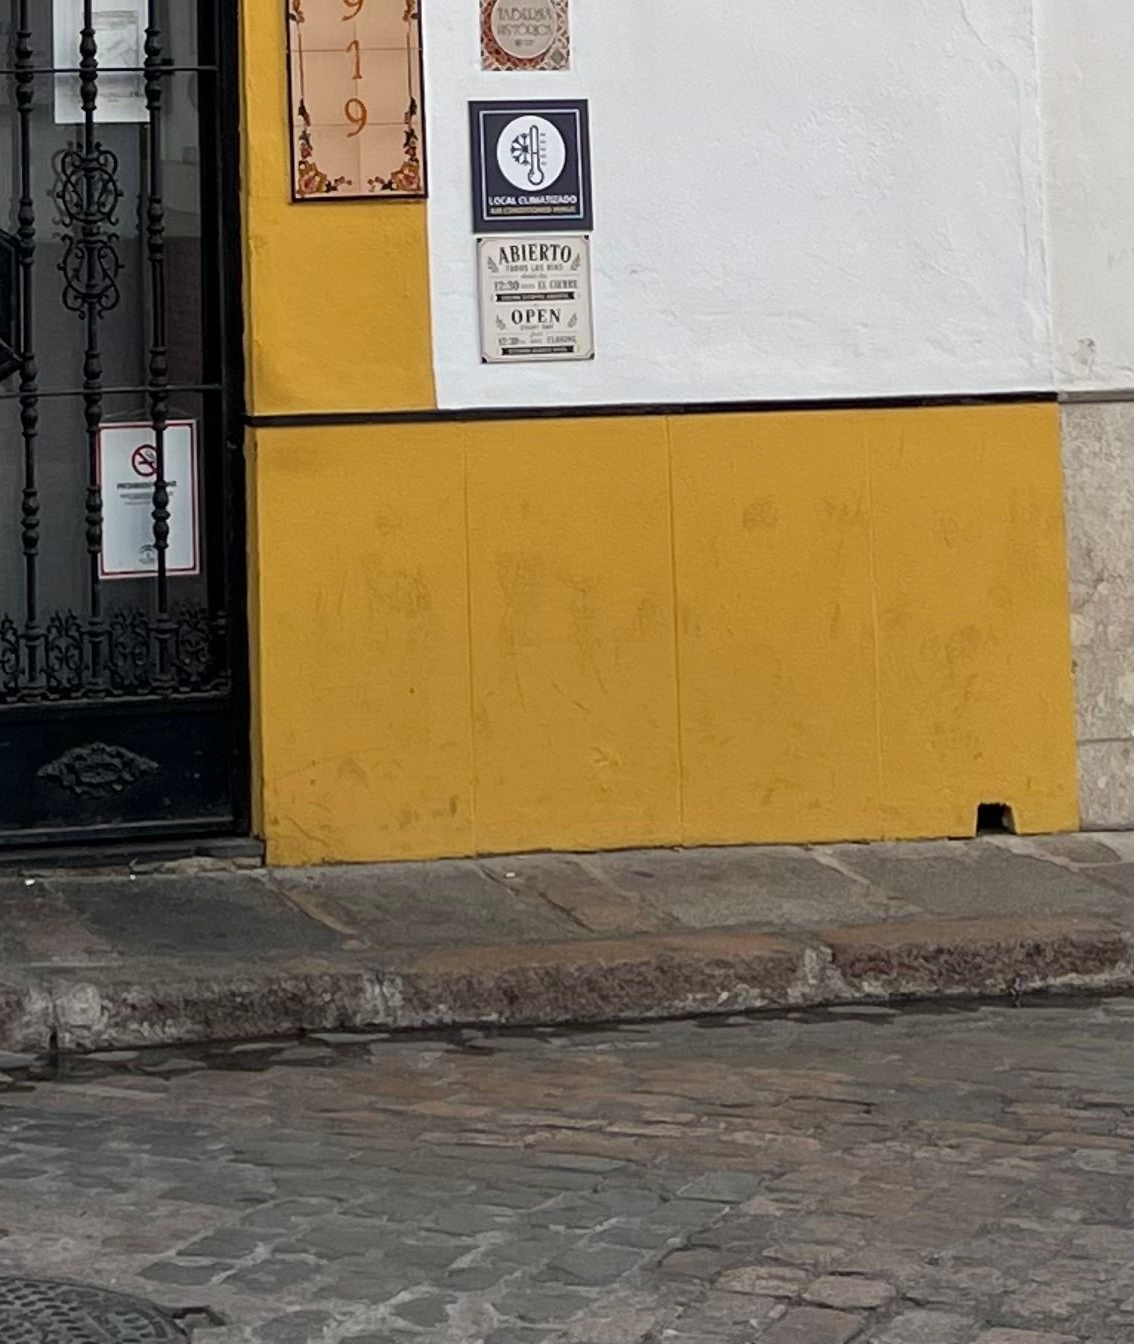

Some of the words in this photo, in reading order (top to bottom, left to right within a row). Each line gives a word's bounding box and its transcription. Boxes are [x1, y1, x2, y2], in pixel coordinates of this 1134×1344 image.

[488, 196, 516, 205] LOCAL
[498, 243, 572, 265] ABIERTO
[511, 308, 561, 325] OPEN
